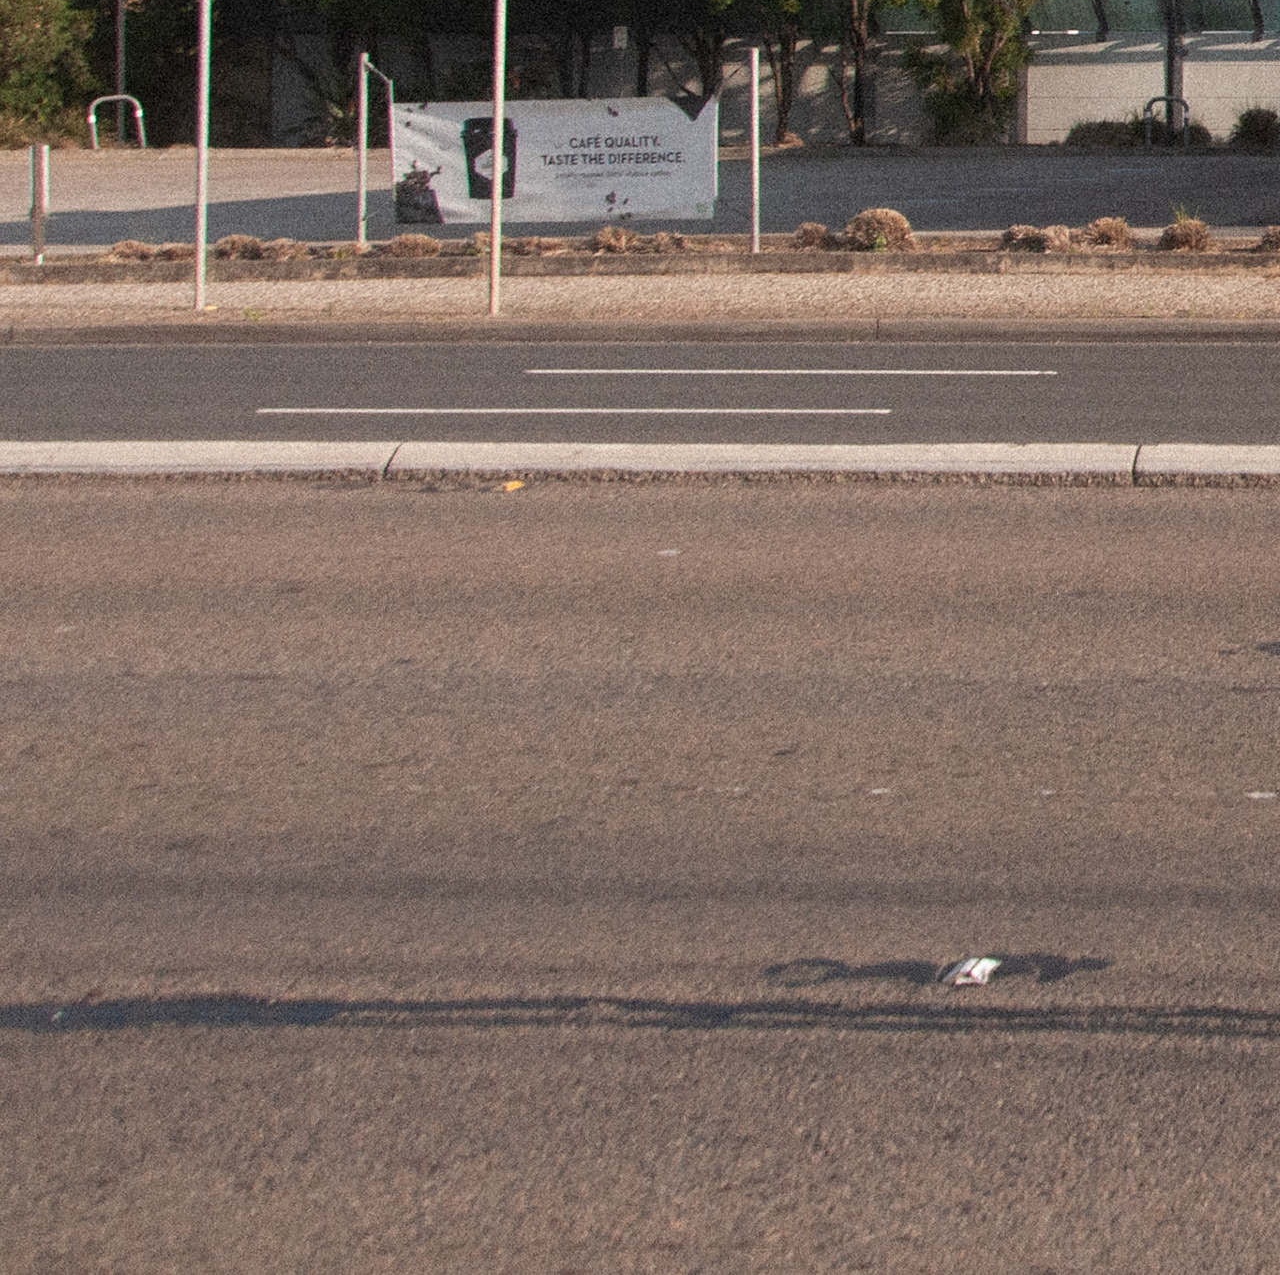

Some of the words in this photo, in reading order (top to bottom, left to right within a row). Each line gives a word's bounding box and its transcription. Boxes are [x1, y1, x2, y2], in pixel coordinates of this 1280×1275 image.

[569, 133, 601, 149] CAFÉ
[604, 135, 661, 149] QUALITY.
[542, 154, 578, 166] TASTE
[582, 153, 605, 165] THE
[608, 152, 686, 165] DIFFERENCE.
